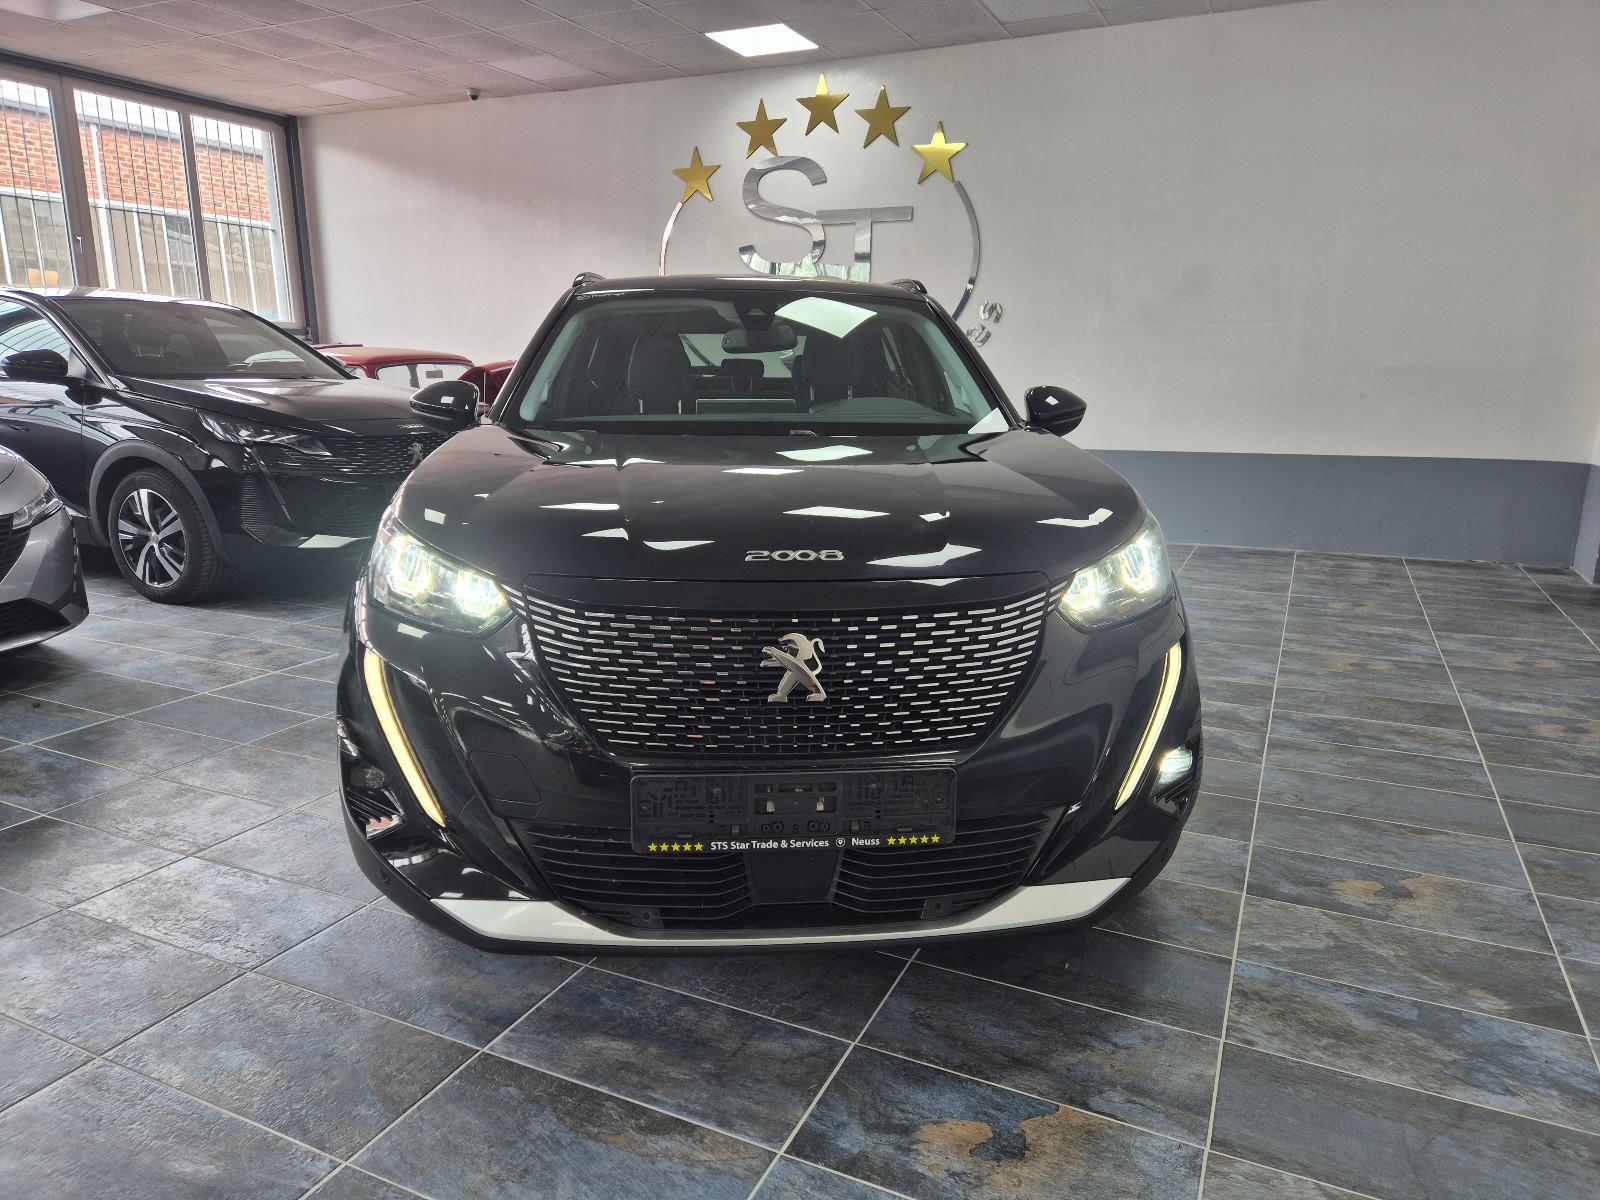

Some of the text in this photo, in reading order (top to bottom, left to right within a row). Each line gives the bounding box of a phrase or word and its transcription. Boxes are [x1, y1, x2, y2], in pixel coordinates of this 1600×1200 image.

[744, 550, 845, 562] 2008
[710, 837, 881, 851] STS Star Trade & Services Neuss
